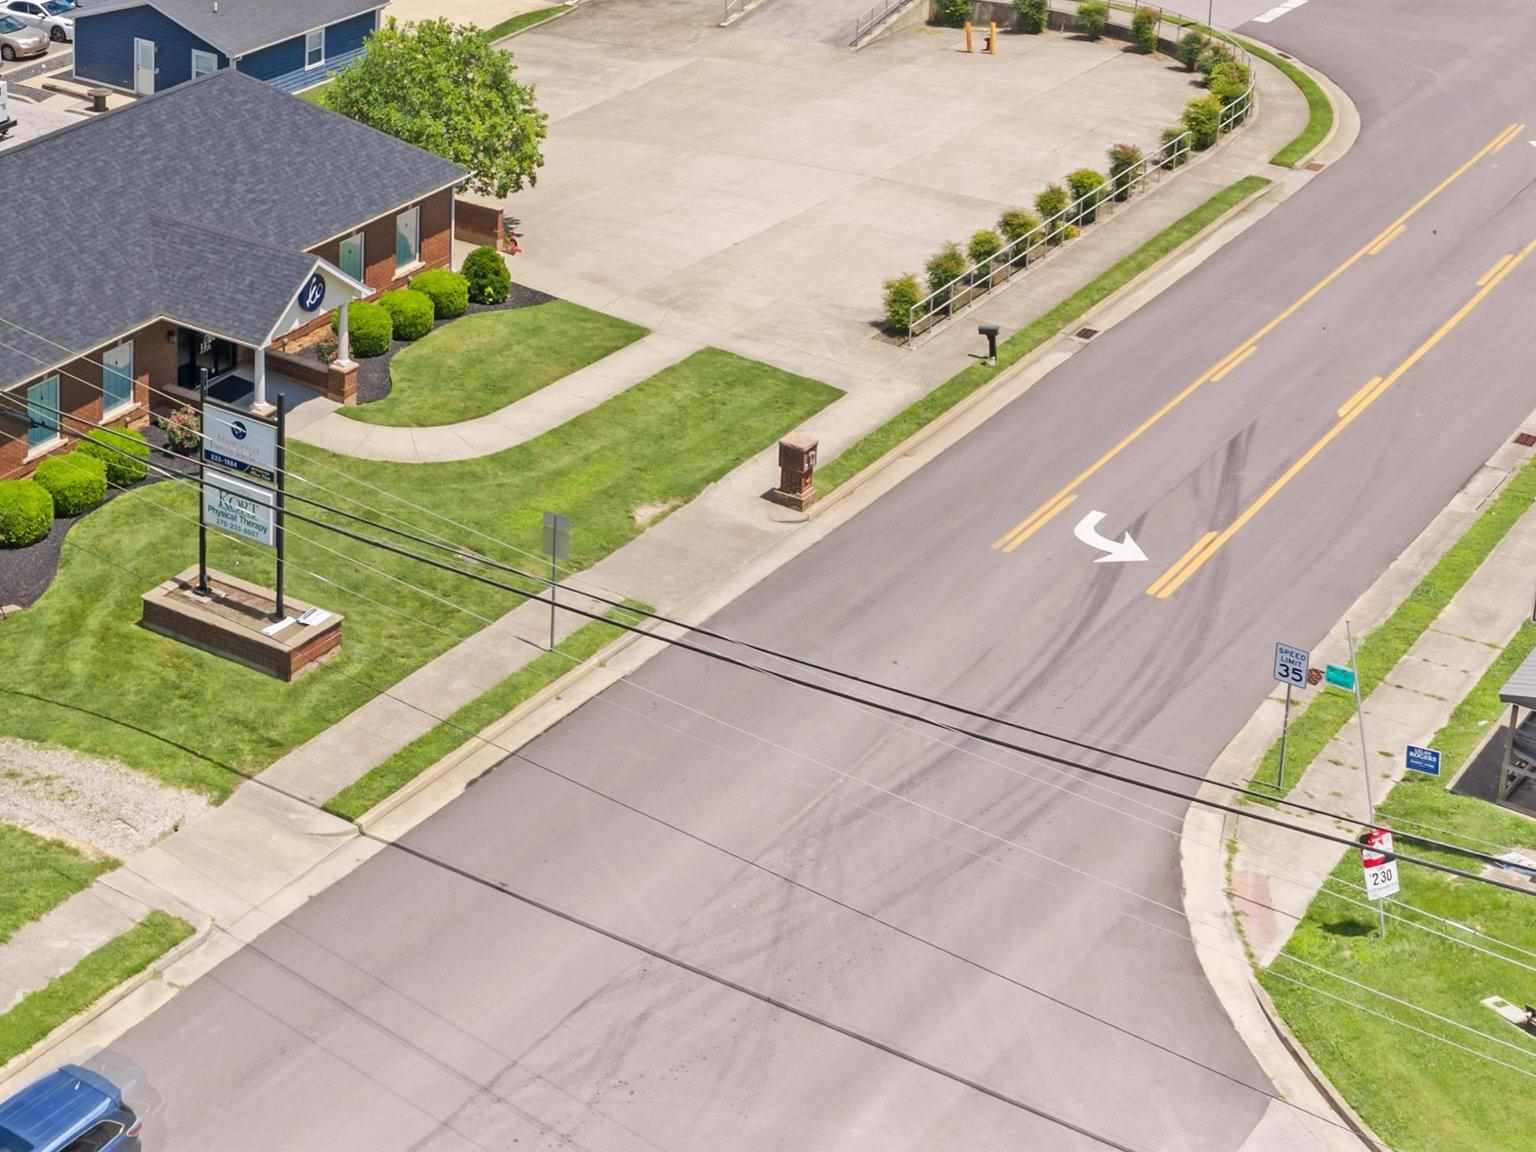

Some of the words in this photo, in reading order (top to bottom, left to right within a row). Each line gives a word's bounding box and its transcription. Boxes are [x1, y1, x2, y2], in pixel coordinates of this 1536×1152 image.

[208, 504, 238, 521] Physical
[239, 515, 268, 535] Therapy
[1279, 647, 1306, 662] SPEED
[1280, 656, 1302, 666] LIMIT
[1278, 663, 1303, 682] 35
